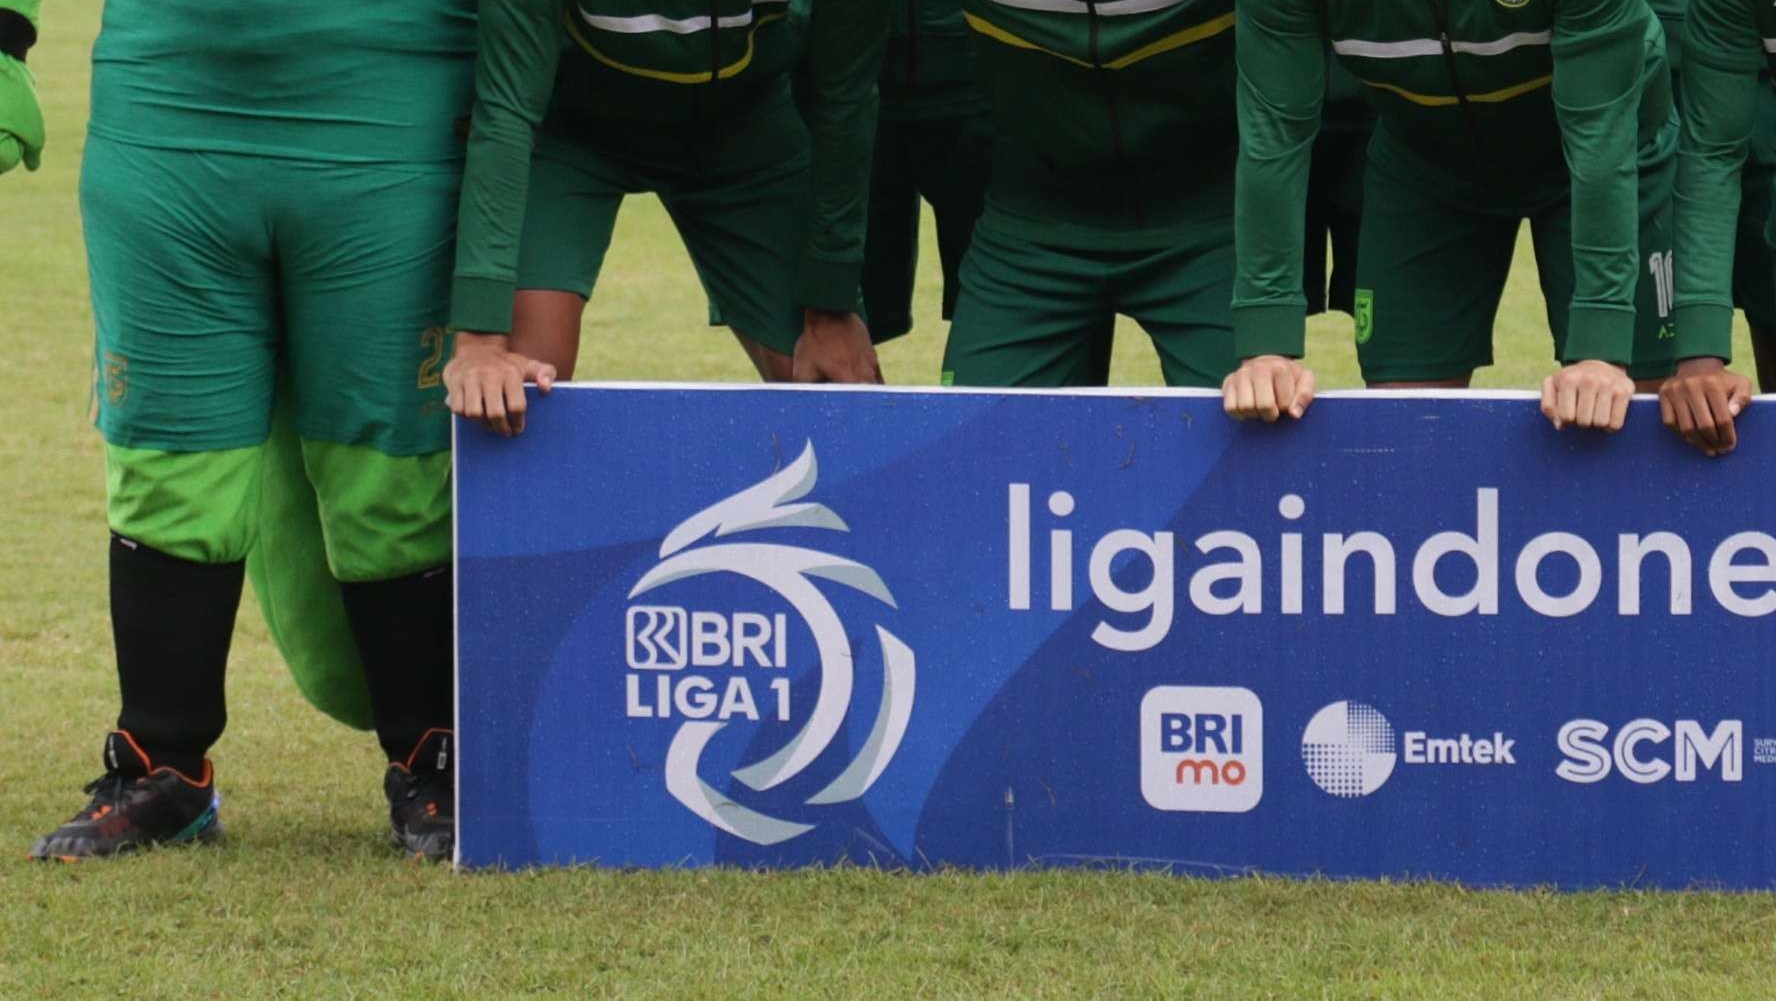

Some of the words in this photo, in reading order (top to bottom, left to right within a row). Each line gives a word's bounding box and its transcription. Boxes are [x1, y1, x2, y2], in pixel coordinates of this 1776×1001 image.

[691, 611, 787, 668] BRI
[626, 673, 760, 720] LIGA
[770, 677, 790, 721] 1
[1160, 713, 1242, 754] BRI
[1403, 731, 1517, 765] Emtek
[1555, 718, 1743, 784] SCM
[1175, 759, 1246, 786] mo
